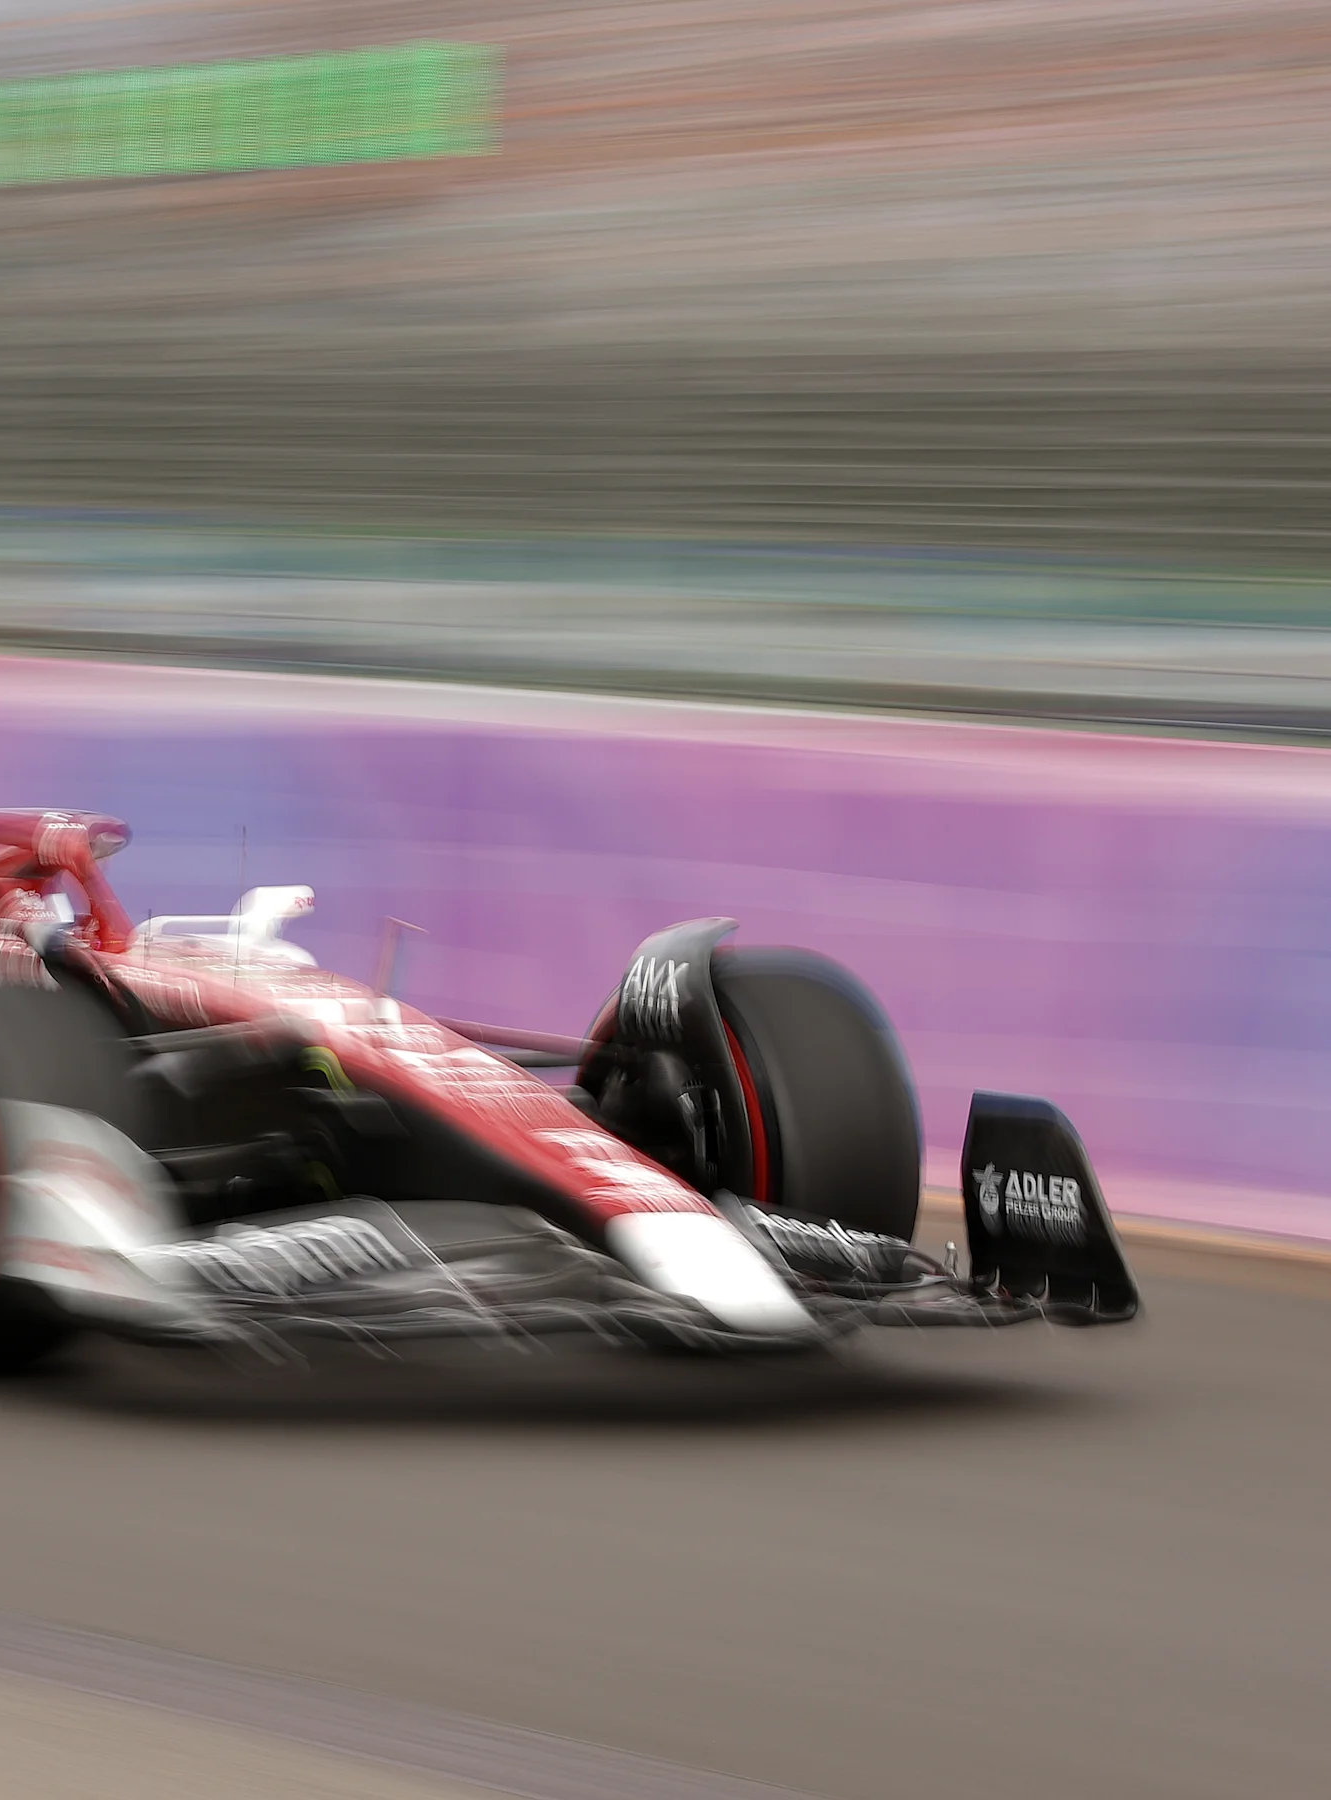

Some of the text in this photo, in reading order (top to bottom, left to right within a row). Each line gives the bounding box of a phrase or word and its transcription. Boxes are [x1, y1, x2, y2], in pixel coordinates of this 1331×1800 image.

[17, 911, 56, 919] SINGHA
[1005, 1169, 1079, 1208] ADLER
[1041, 1201, 1081, 1222] GROUP
